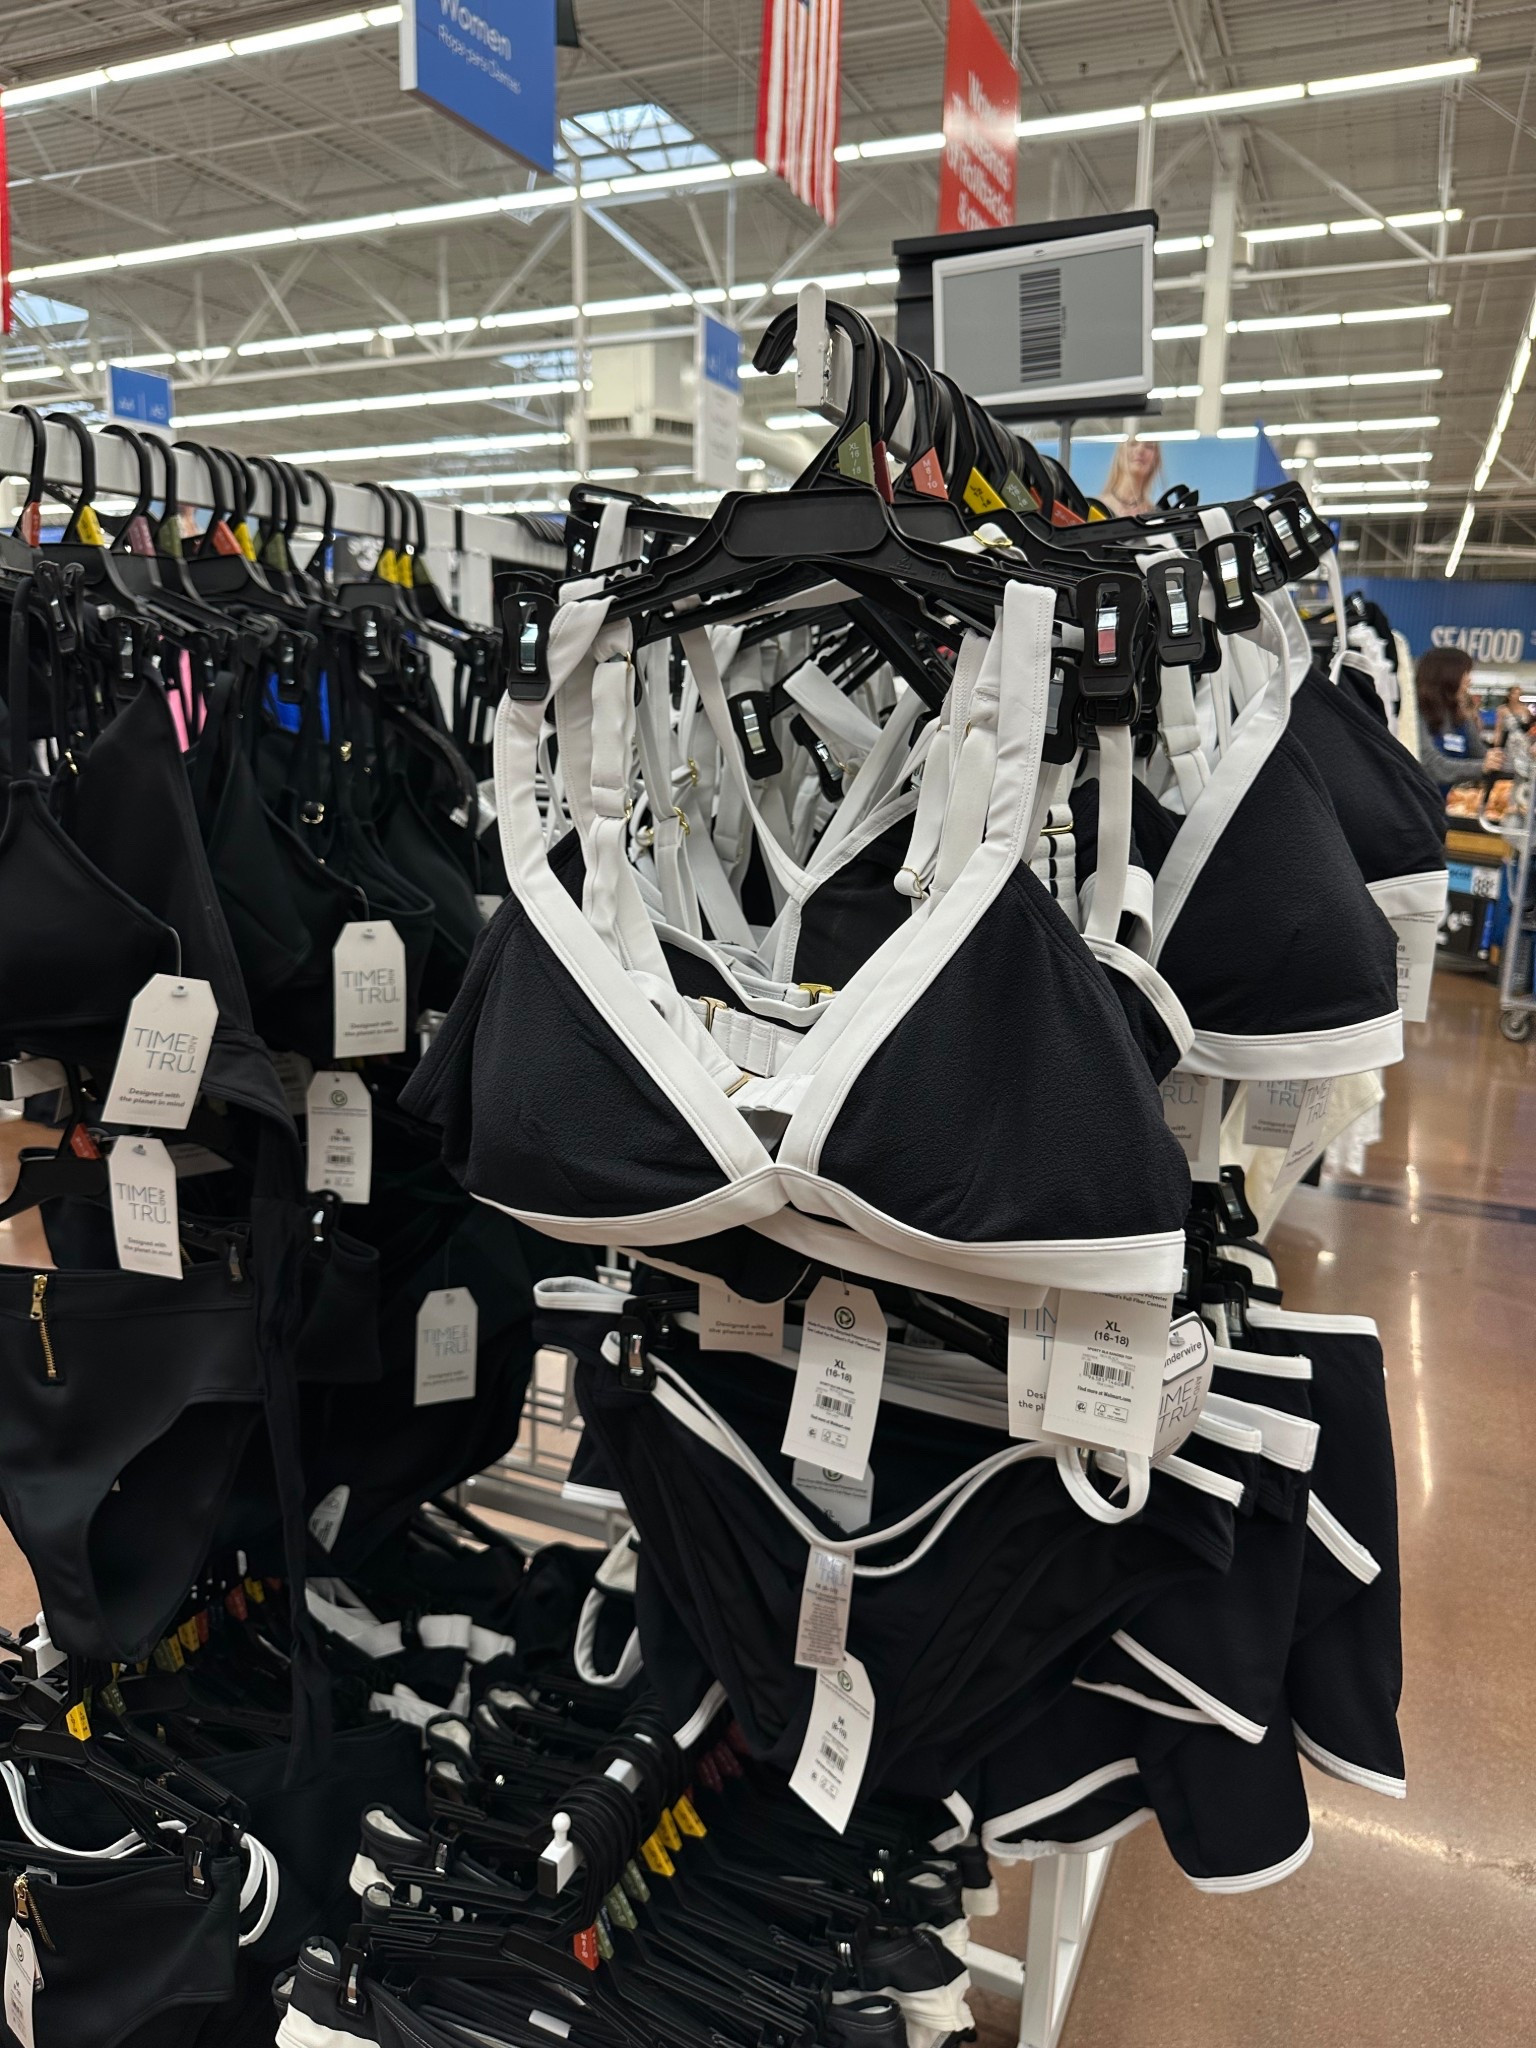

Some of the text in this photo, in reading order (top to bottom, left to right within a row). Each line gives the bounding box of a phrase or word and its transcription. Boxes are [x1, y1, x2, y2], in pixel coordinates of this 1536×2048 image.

[1431, 625, 1524, 664] SEAFOOD
[341, 968, 389, 988] TIME
[134, 1027, 189, 1053] TIME
[128, 1087, 164, 1098] Designed
[1163, 1085, 1194, 1104] RU
[119, 1095, 132, 1103] the
[132, 1096, 157, 1106] planet
[166, 1100, 186, 1108] mind
[115, 1183, 159, 1206] TIME
[1146, 1300, 1167, 1310] Content
[715, 1320, 750, 1329] Designed
[1105, 1320, 1121, 1332] XL
[1094, 1331, 1130, 1347] (16-18)
[834, 1359, 846, 1370] XL
[826, 1368, 852, 1383] (16-18)
[1027, 1389, 1047, 1399] Desi
[1159, 1377, 1195, 1416] IME
[1018, 1400, 1045, 1412] the pl
